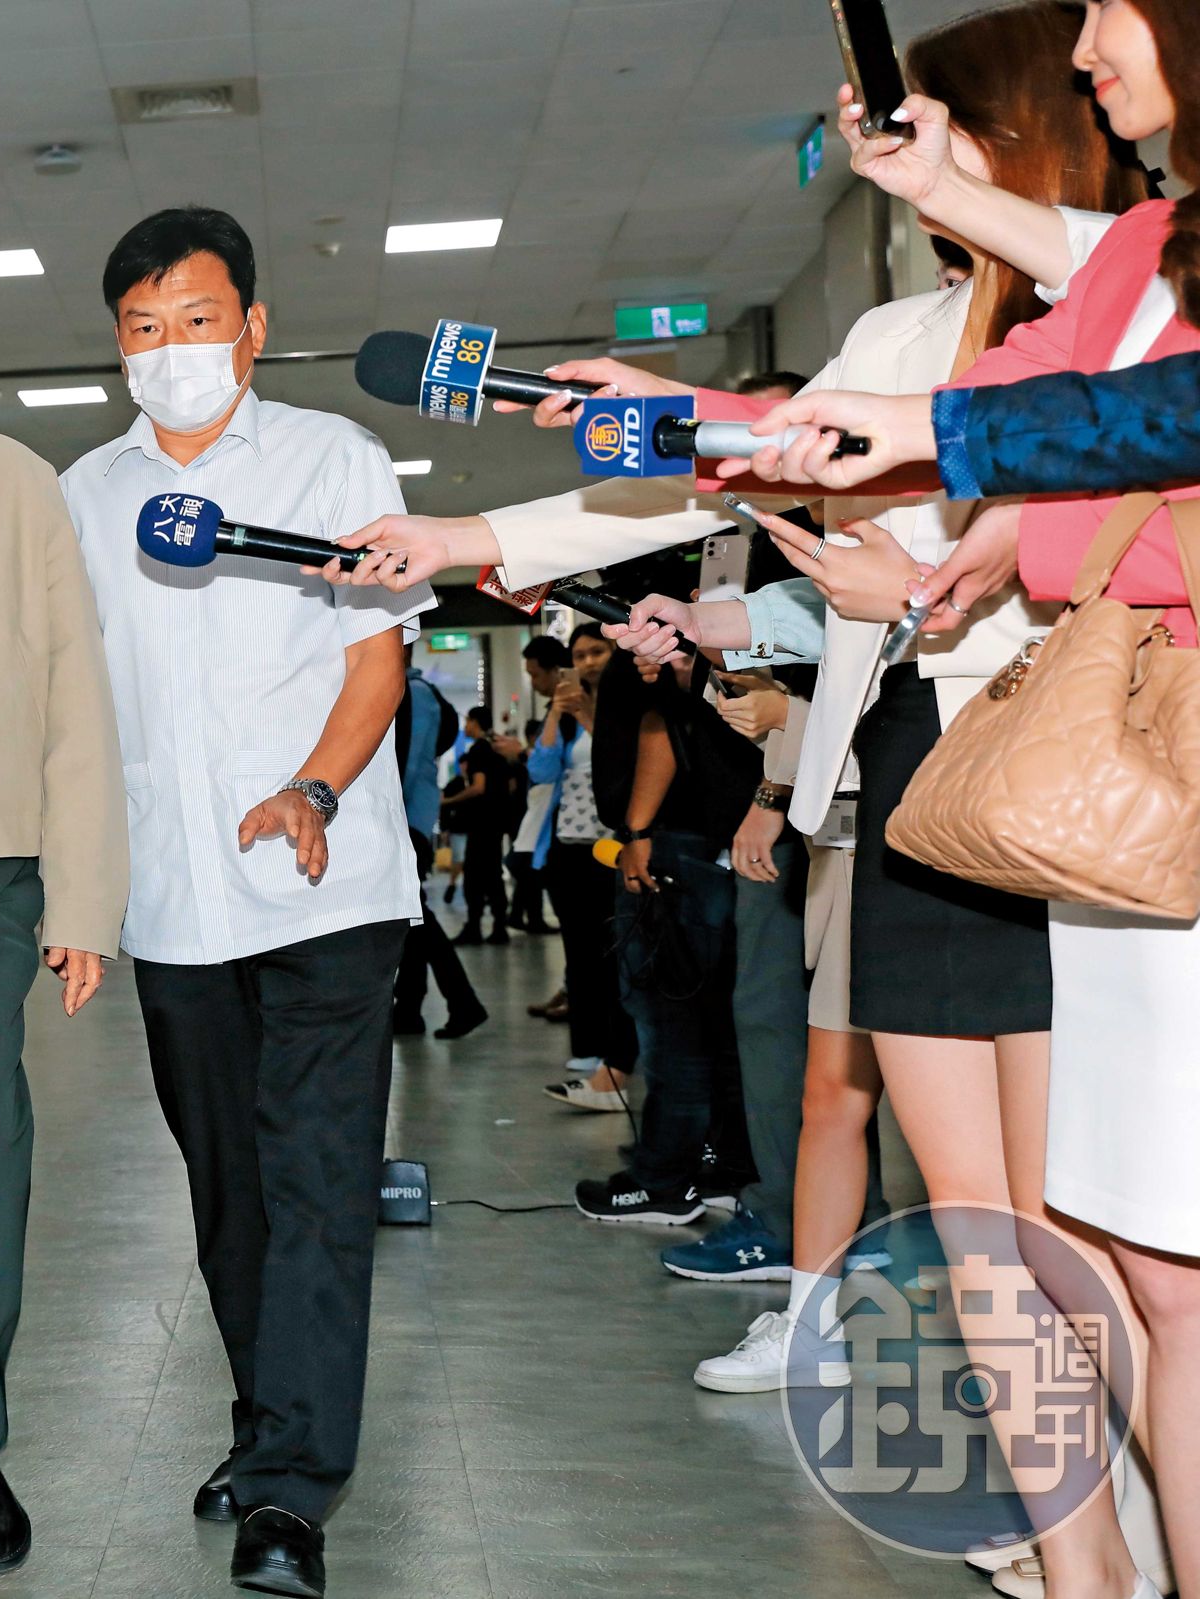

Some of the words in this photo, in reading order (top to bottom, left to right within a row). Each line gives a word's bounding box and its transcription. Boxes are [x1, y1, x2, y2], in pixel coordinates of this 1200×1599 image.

[431, 322, 463, 379] mnews
[456, 338, 485, 364] 86
[623, 406, 640, 469] NTD
[380, 1186, 423, 1200] MIPRO
[611, 1189, 650, 1207] HOKA
